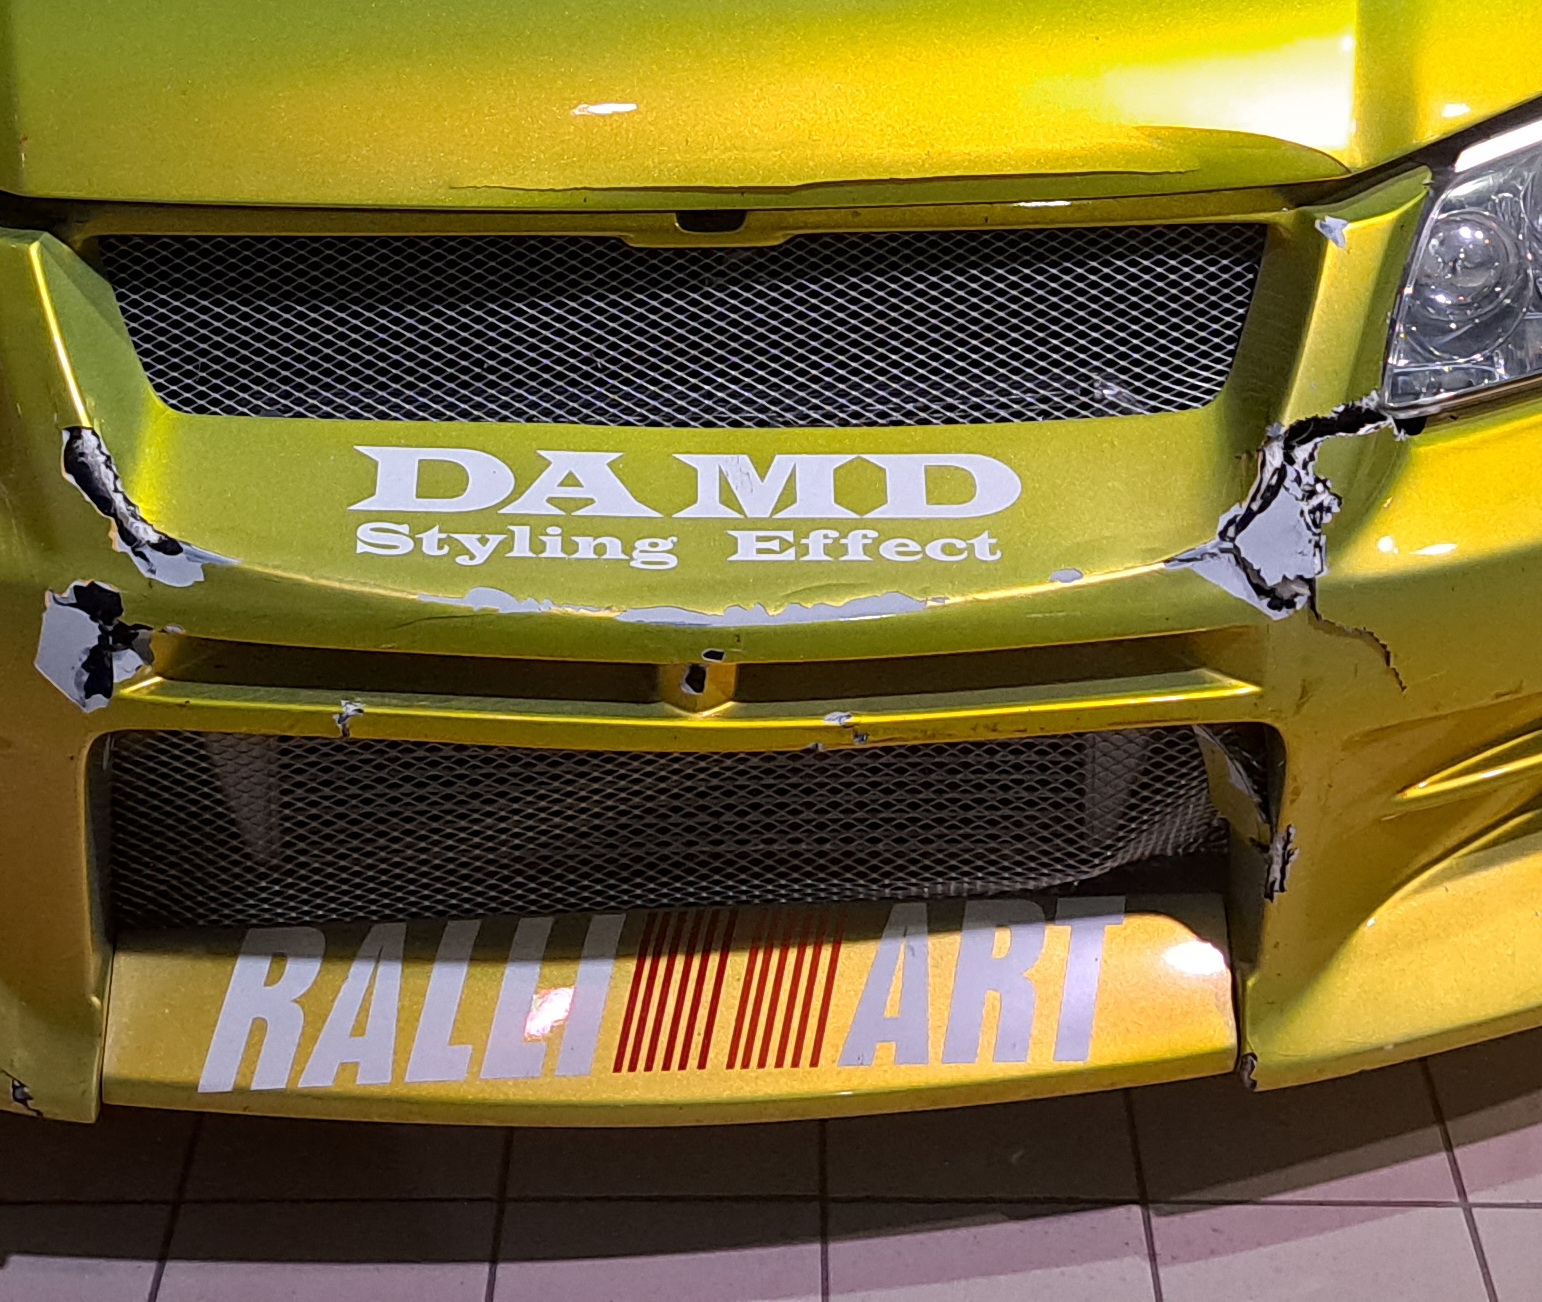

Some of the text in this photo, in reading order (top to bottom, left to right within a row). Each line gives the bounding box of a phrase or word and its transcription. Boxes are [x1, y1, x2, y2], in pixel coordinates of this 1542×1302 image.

[347, 445, 1023, 519] DAMD
[355, 522, 1003, 570] Styling Effect
[197, 896, 1126, 1093] RALLI ART
